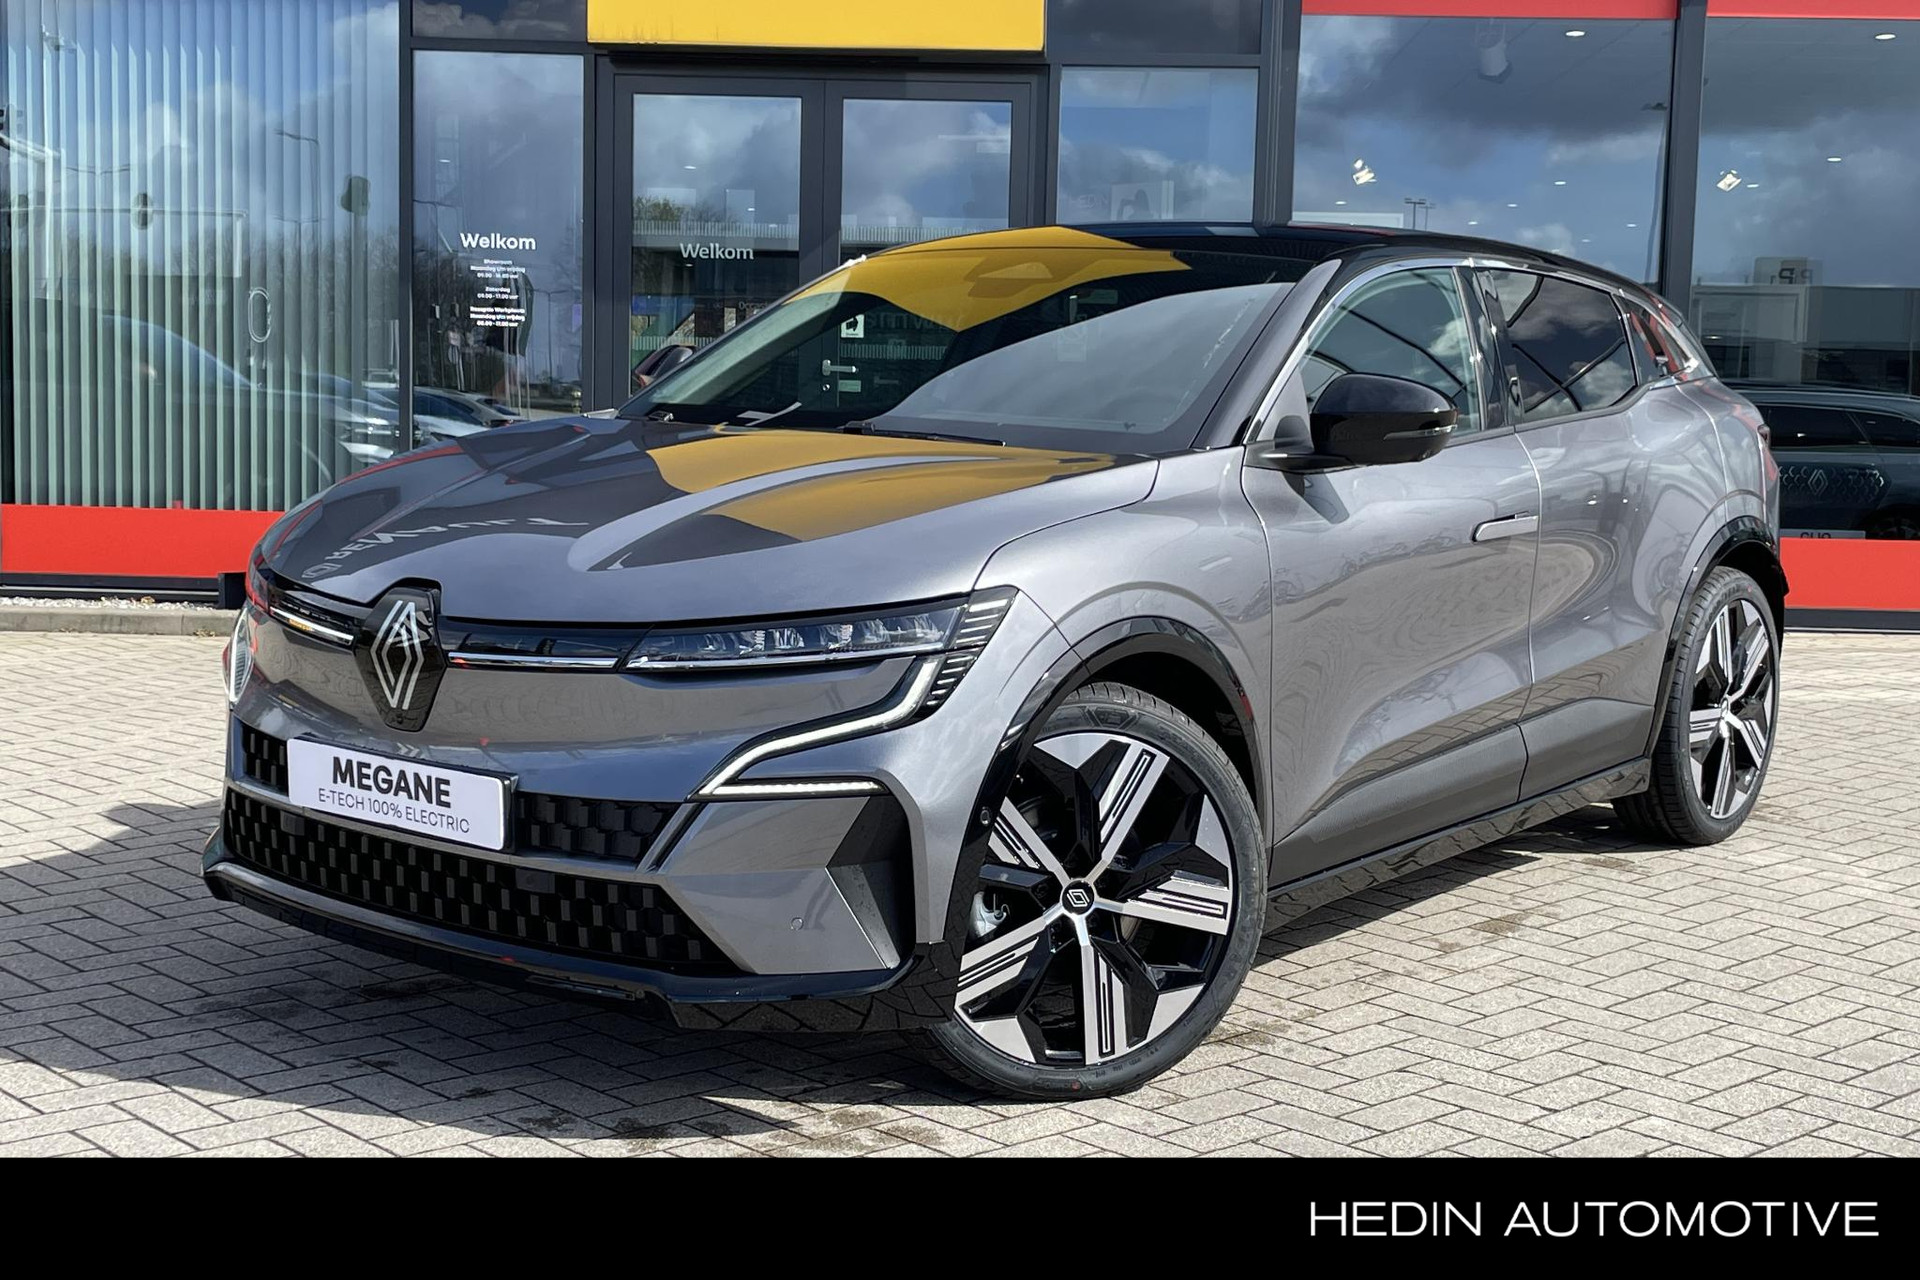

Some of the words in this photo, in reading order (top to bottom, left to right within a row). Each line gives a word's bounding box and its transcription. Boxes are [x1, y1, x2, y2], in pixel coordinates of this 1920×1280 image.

[460, 232, 536, 250] Welkom
[679, 243, 754, 260] Welkom
[332, 756, 451, 808] MEGANE
[318, 788, 365, 811] E-TECH
[368, 798, 403, 819] 100%
[405, 806, 470, 833] ELECTRIC
